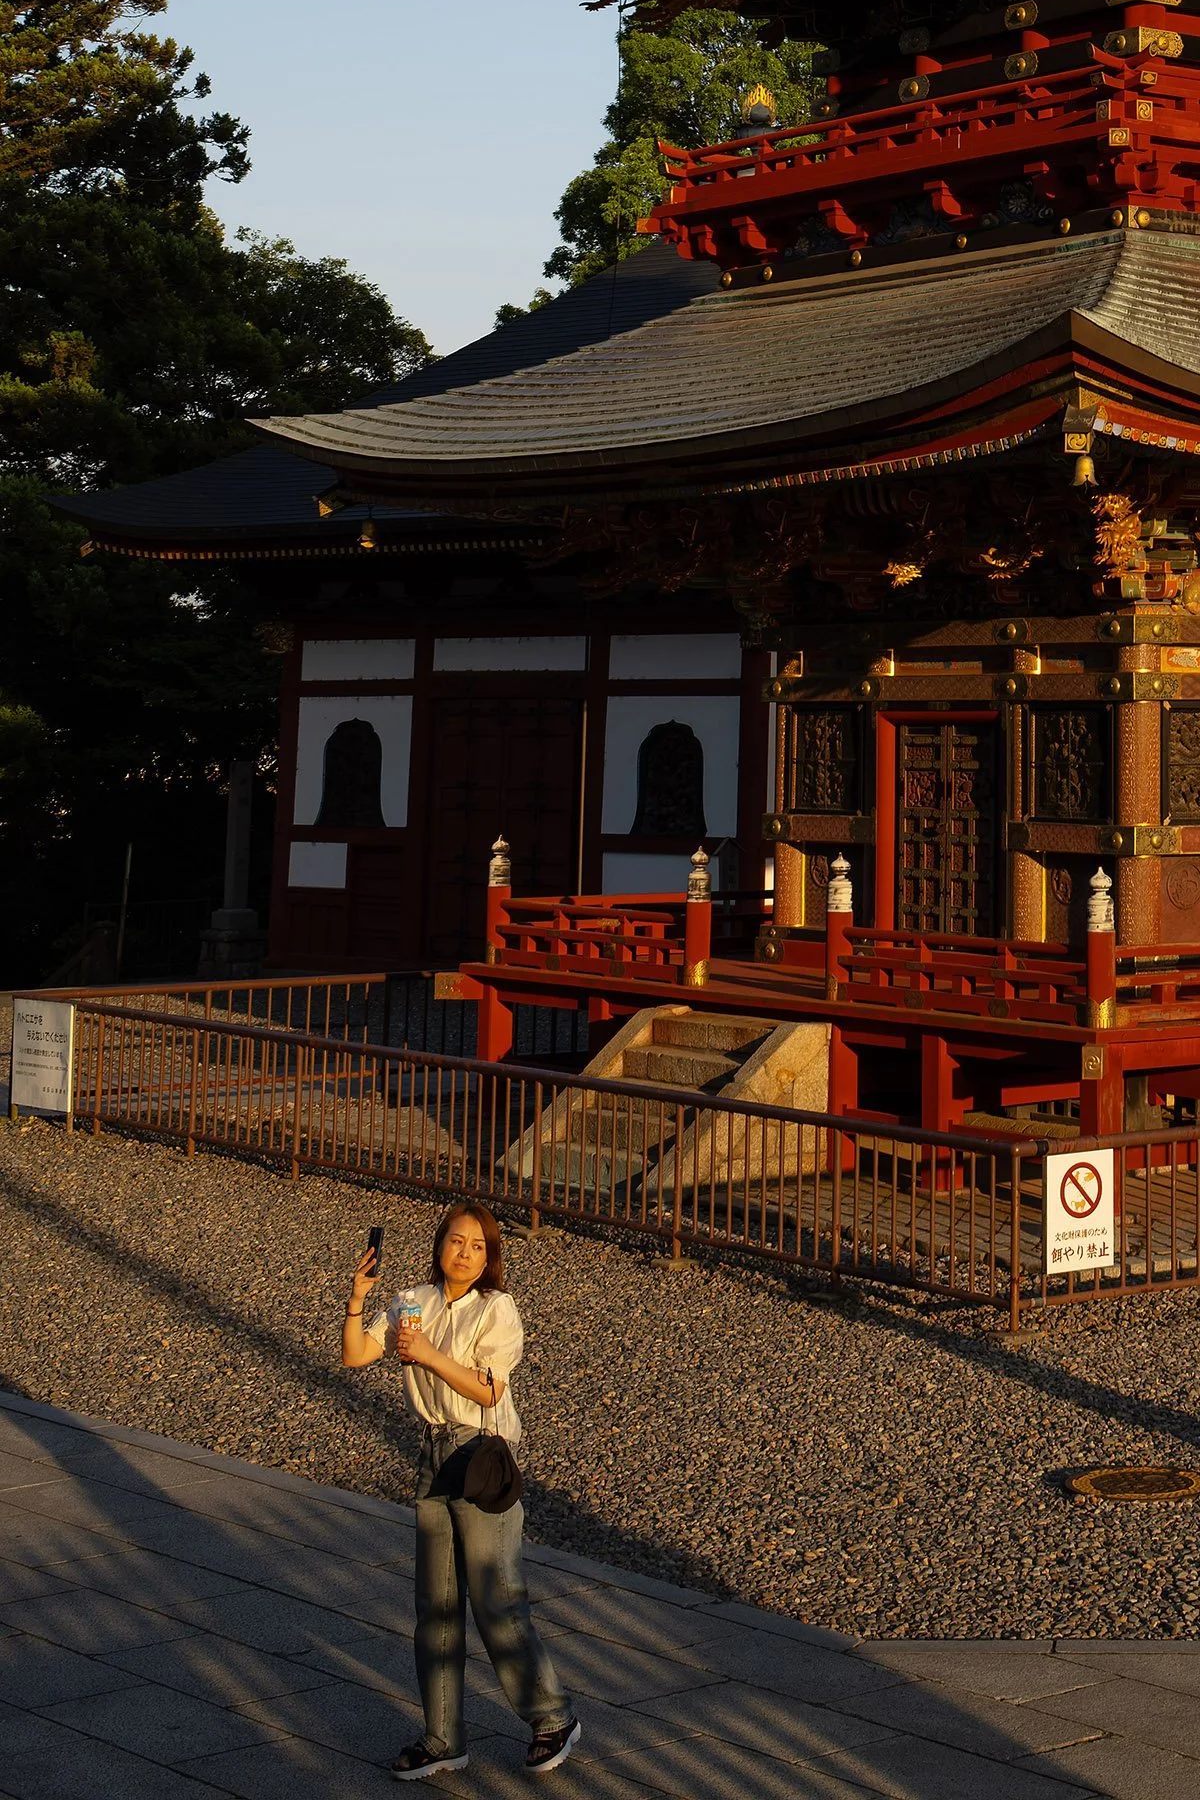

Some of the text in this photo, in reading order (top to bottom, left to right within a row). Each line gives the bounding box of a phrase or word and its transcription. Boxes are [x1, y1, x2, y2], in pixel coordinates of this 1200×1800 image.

[26, 1030, 68, 1044] 与えないでください
[1055, 1227, 1107, 1242] 文化財保護のため
[1051, 1241, 1110, 1263] 餌やり禁止
